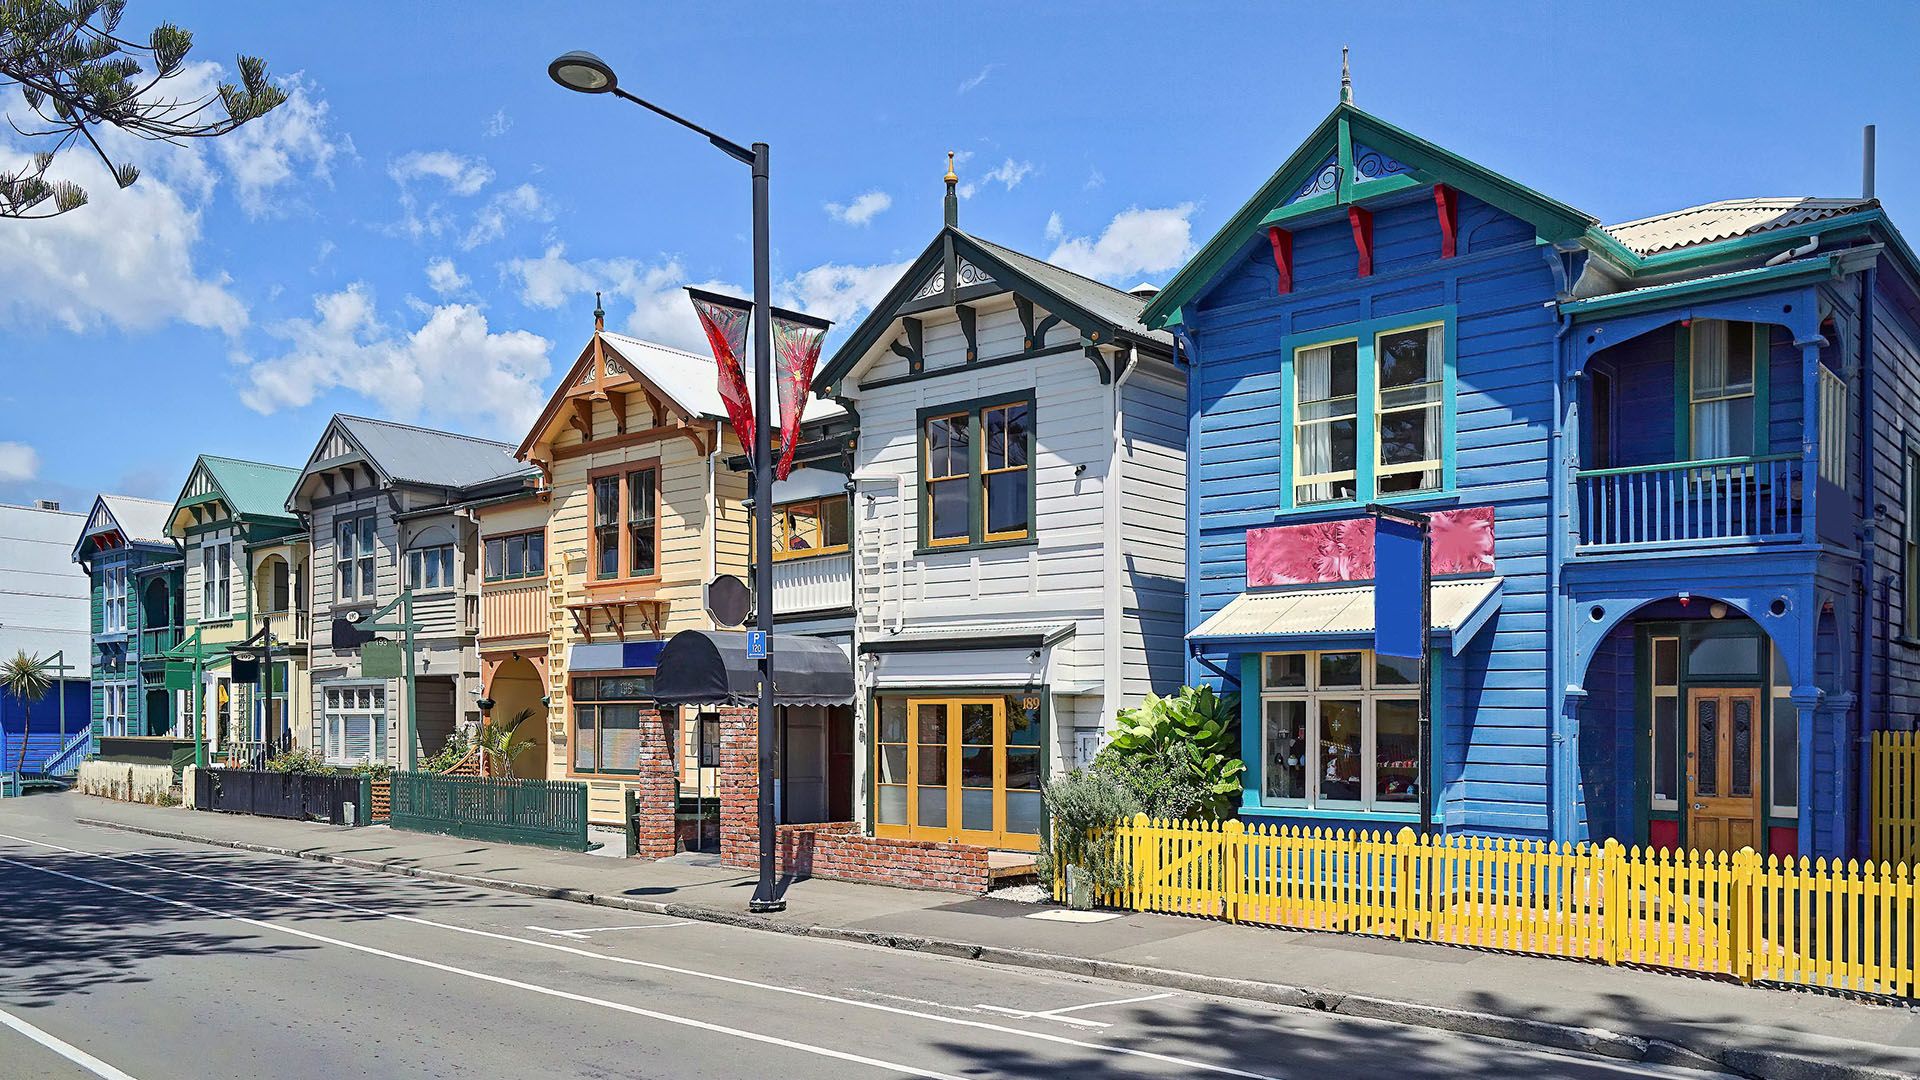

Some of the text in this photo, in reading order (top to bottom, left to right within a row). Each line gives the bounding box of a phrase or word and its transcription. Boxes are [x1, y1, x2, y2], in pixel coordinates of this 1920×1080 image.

[753, 633, 760, 643] P
[752, 644, 762, 653] 120
[1022, 696, 1041, 710] 189
